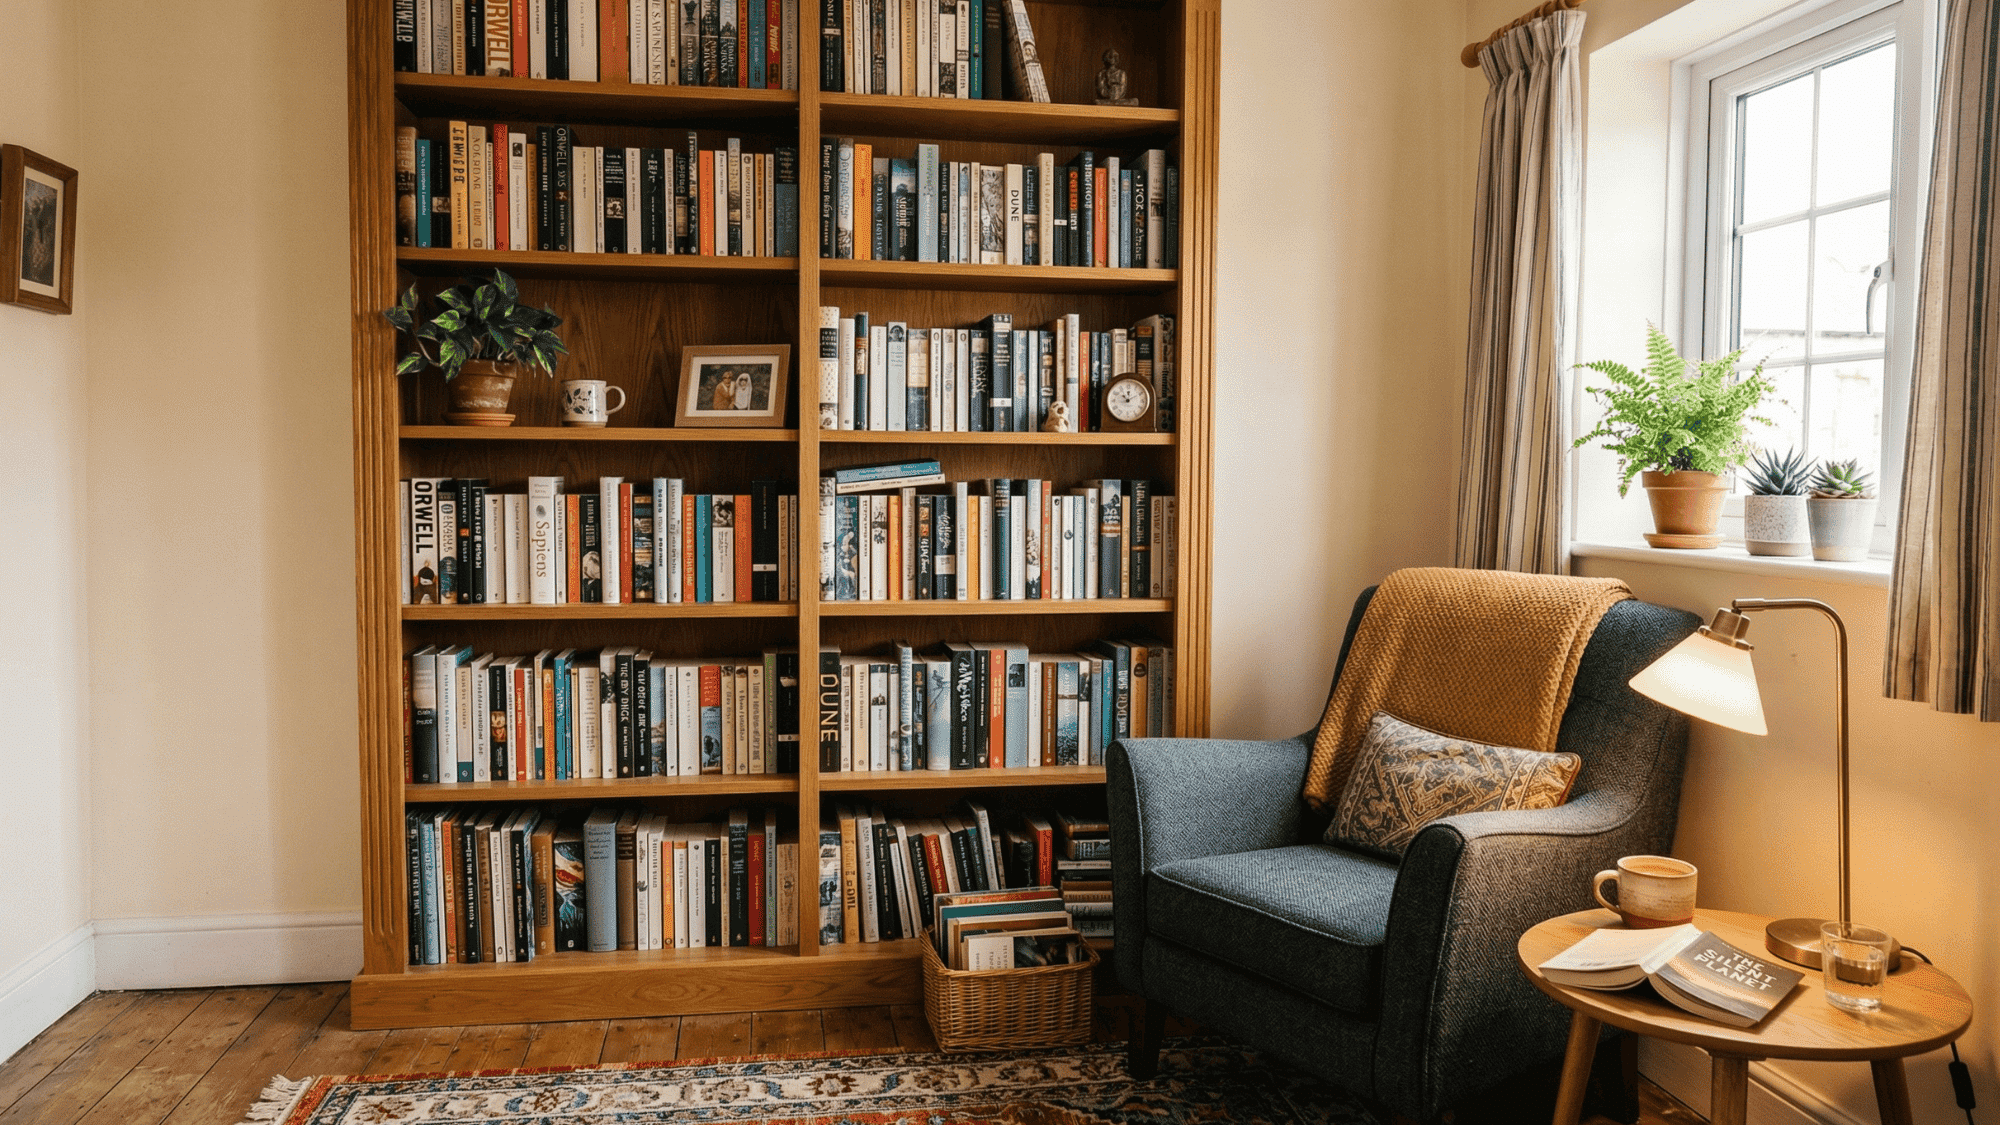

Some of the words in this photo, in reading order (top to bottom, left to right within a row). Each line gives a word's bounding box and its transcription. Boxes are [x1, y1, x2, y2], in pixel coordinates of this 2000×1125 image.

[1011, 189, 1020, 222] DUNE
[414, 480, 434, 554] ORWELL
[531, 520, 551, 578] Sapiens
[820, 673, 839, 742] DUNE
[1693, 953, 1772, 991] PLANET
[1703, 949, 1777, 984] SILENT
